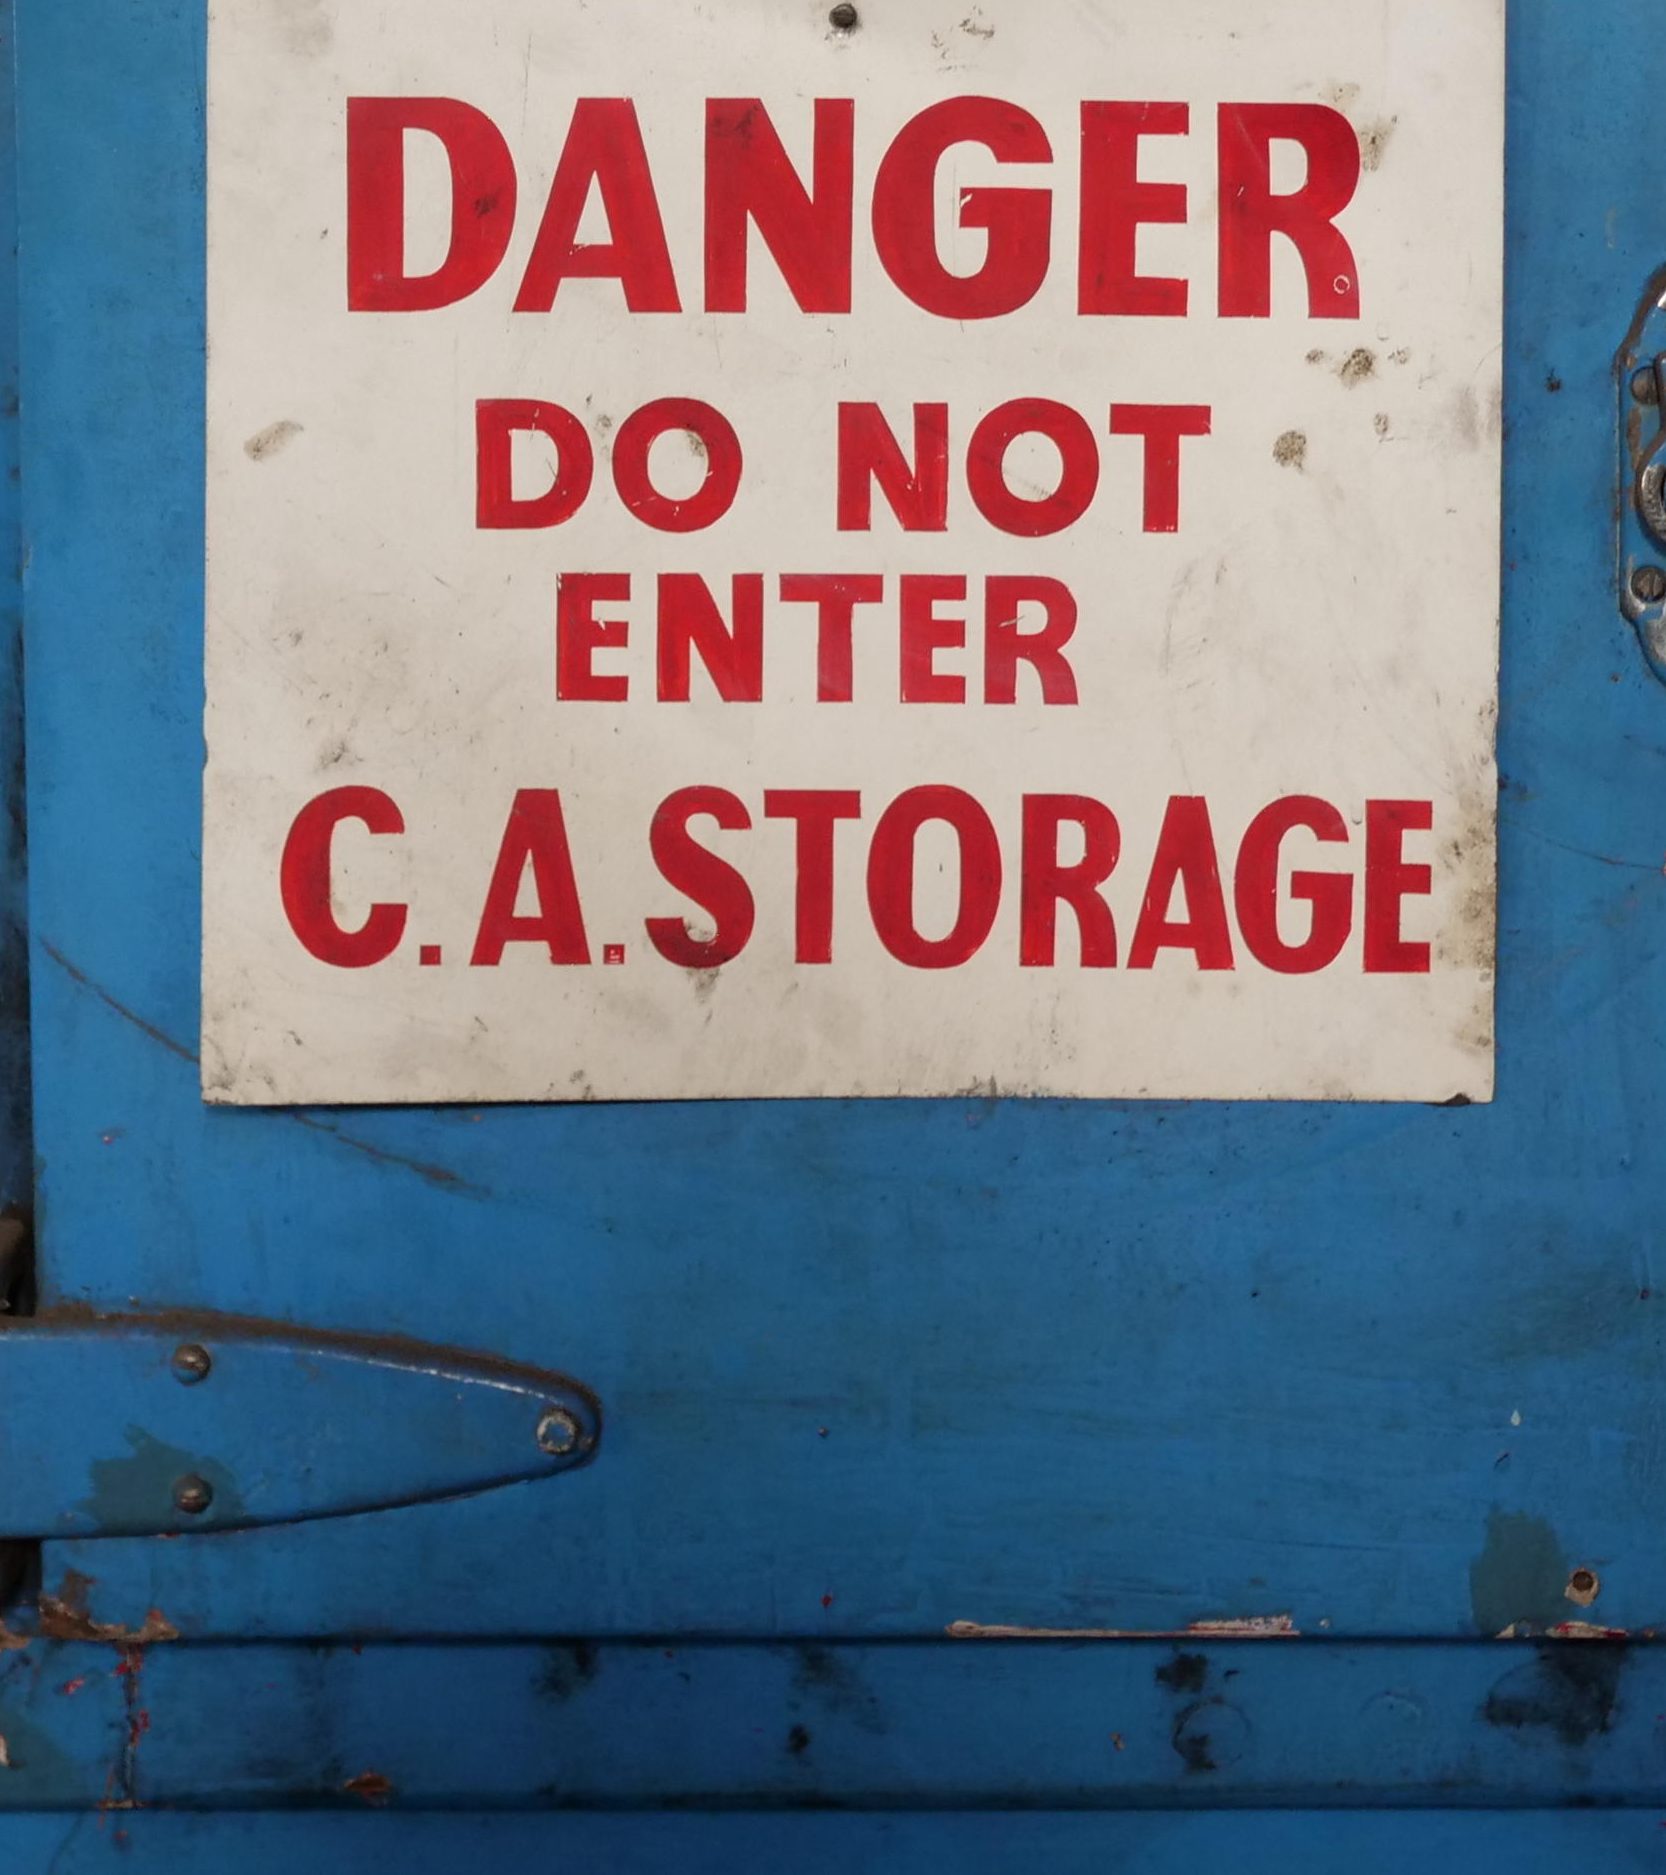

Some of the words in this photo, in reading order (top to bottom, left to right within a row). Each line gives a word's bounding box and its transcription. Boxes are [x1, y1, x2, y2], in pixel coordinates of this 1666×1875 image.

[347, 95, 1362, 323] DANGER
[476, 398, 743, 533] DO
[837, 397, 1213, 537] NOT
[556, 573, 1079, 705] ENTER
